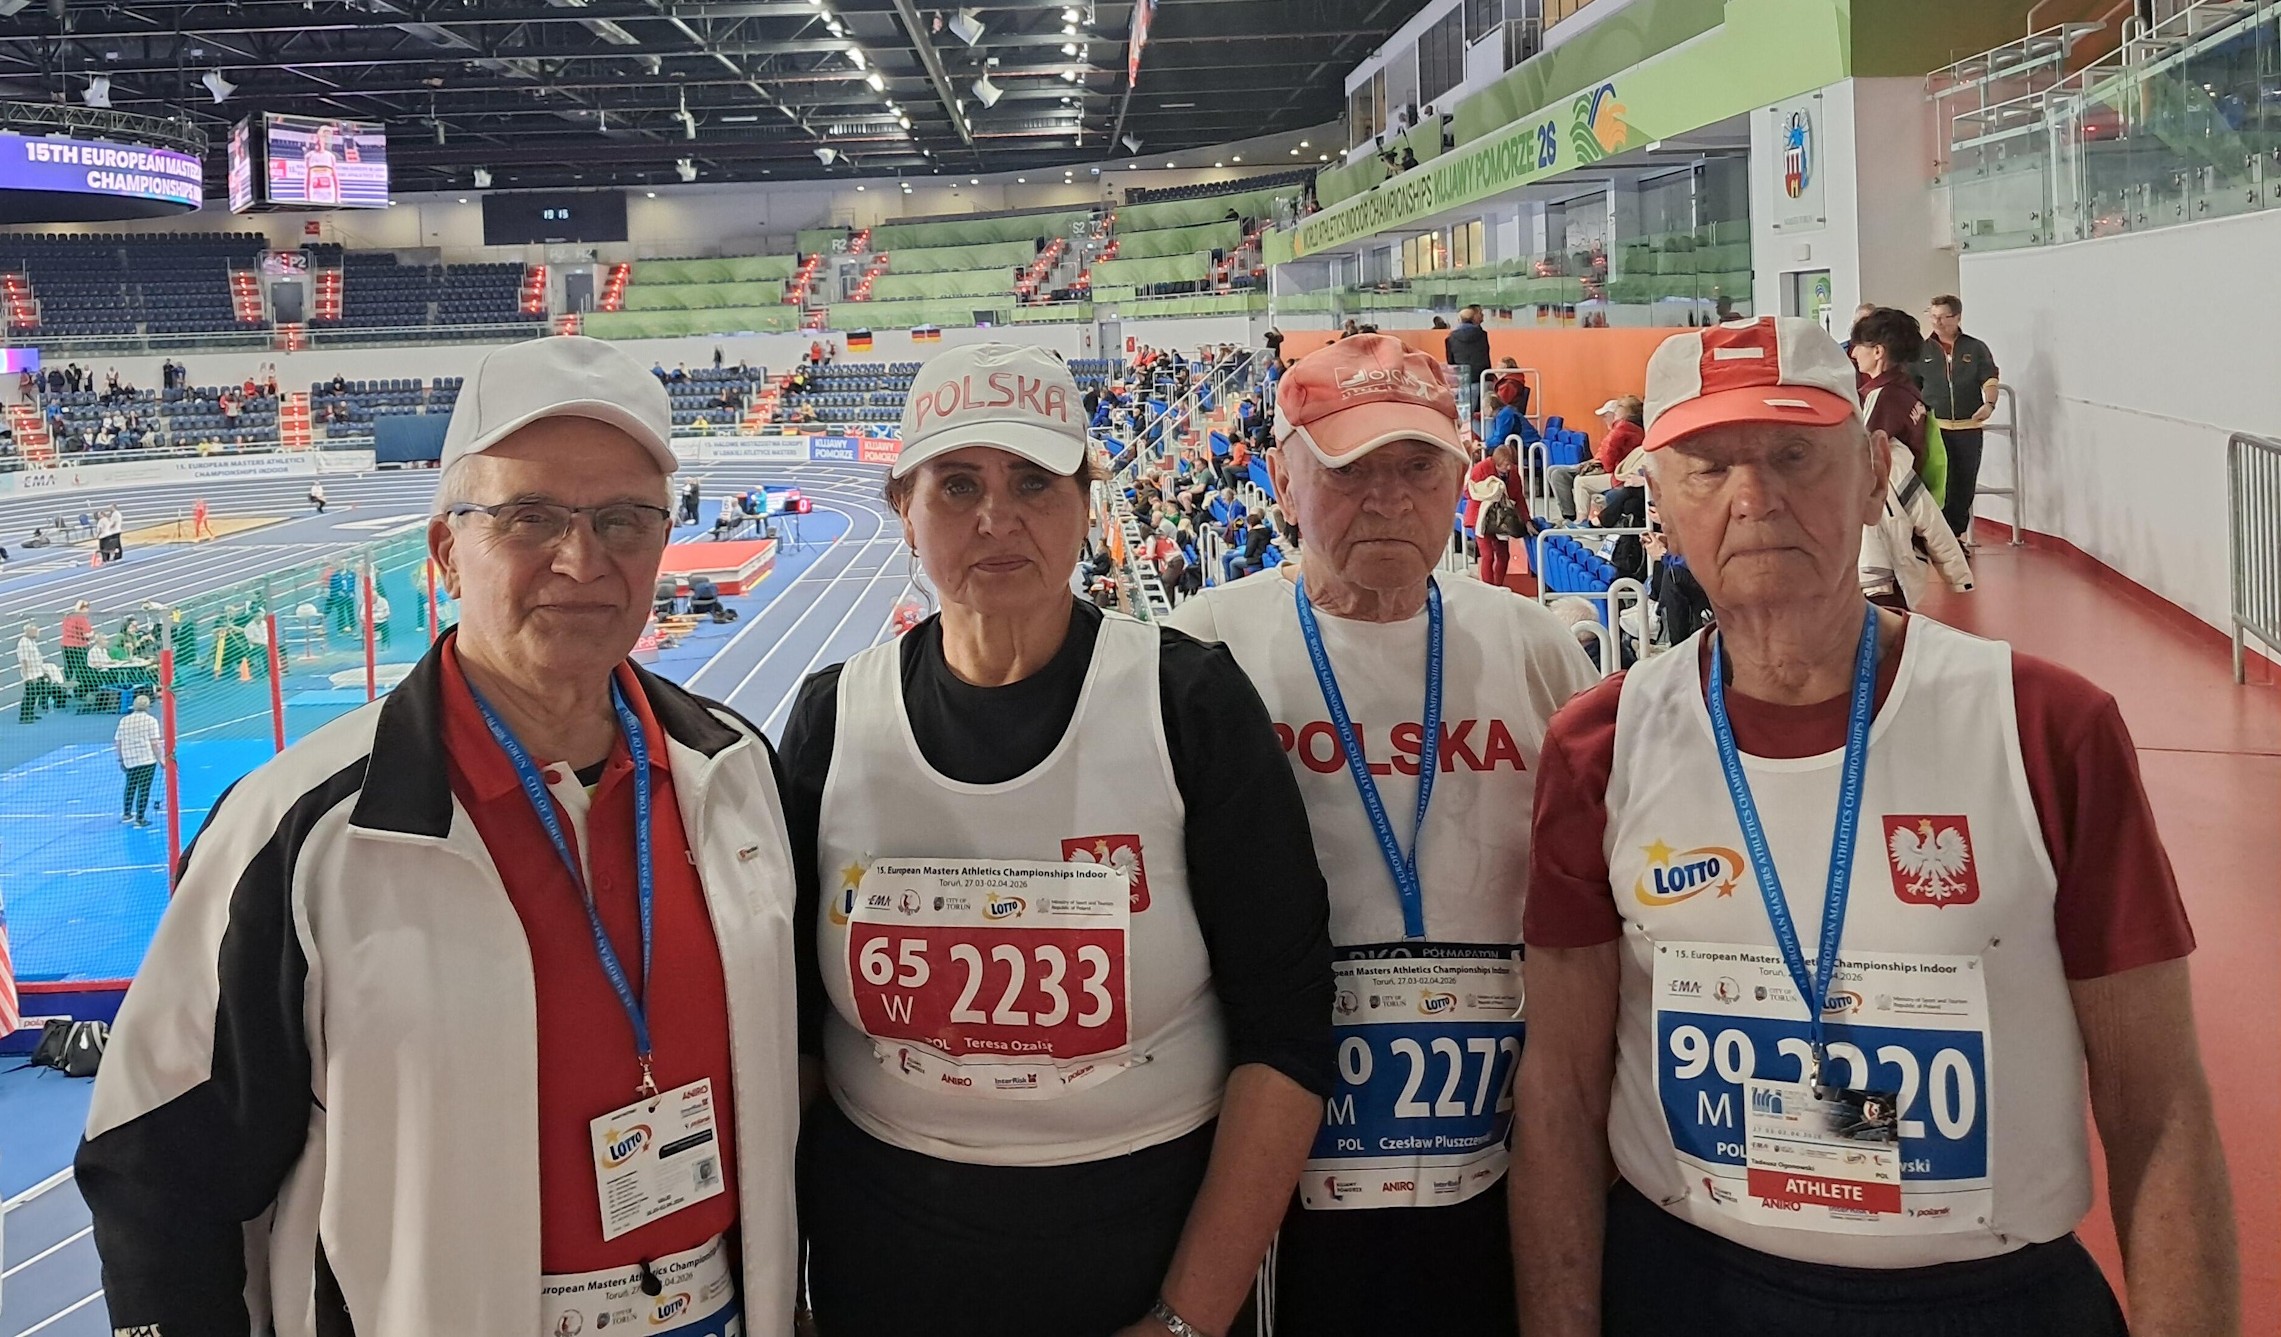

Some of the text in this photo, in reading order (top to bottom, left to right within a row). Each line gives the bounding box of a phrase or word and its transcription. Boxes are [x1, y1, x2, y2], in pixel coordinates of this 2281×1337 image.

[25, 141, 78, 164] 15TH
[81, 147, 165, 173] EUROPEAN
[86, 170, 193, 199] CHAMPIONSHIPS
[1370, 173, 1432, 228] CHAMPIONSHIPS
[1433, 156, 1474, 202] KUJAWY
[1476, 131, 1535, 189] POMORZE
[1537, 119, 1557, 170] 26
[1072, 221, 1085, 234] S2
[832, 239, 847, 250] R2
[290, 255, 306, 268] P2
[915, 372, 1067, 433] POLSKA
[815, 438, 848, 449] KUJAWY
[815, 449, 853, 460] POMORZE
[864, 441, 895, 451] KUJAWY
[188, 461, 230, 470] EUROPEAN
[230, 459, 265, 467] MASTERS
[266, 456, 305, 465] ATHLETICS
[194, 466, 289, 478] CHAMPIONSHIPS INDOOR
[24, 474, 55, 488] EMA
[1432, 622, 1441, 657] INDOOR
[1310, 636, 1326, 671] INDOOR
[1427, 657, 1441, 727] CHAMPIONSHIPS
[1322, 671, 1351, 742] CHAMPIONSHIPS
[1711, 692, 1724, 730] INDOOR
[1272, 718, 1527, 776] POLSKA
[1424, 727, 1436, 778] ATHLETICS
[1349, 741, 1373, 792] ATHLETICS
[1719, 729, 1750, 809] CHAMPIONSHIPS
[526, 775, 541, 800] CITY
[1366, 791, 1388, 835] MASTERS
[1743, 809, 1768, 865] ATHLETICS
[1821, 682, 1869, 983] EUROPEAN MASTERS ATHLETICS CHAMPIONSHIPS INDOOR
[877, 866, 1108, 879] 15. European Masters Athletics Championships Indoor
[1383, 834, 1407, 885] EUROPEAN
[1653, 857, 1720, 894] LOTTO
[1761, 865, 1784, 912] MASTERS
[868, 894, 892, 907] EMA
[991, 901, 1018, 916] LOTTO
[1675, 950, 1689, 959] 15.
[1691, 951, 1737, 962] European
[1740, 953, 1780, 964] Masters
[1777, 915, 1804, 975] EUROPEAN
[596, 935, 625, 994] EUROPEAN
[859, 936, 931, 988] 65
[1356, 967, 1391, 976] Masters
[1393, 965, 1431, 975] Athletics
[1433, 965, 1491, 976] Championships
[1833, 959, 1918, 974] Championships
[1920, 963, 1957, 974] Indoor
[950, 943, 1113, 1028] 2233
[1670, 979, 1701, 994] EMA
[881, 994, 913, 1025] W
[1425, 997, 1450, 1011] LOTTO
[1823, 996, 1853, 1010] LOTTO
[24, 1018, 44, 1027] pola
[964, 1037, 1009, 1050] Teresa
[1670, 1026, 1755, 1084] 90
[1338, 1036, 1373, 1086] 0
[941, 1073, 972, 1088] ANIRO
[1390, 1036, 1521, 1118] 2272
[1327, 1094, 1356, 1126] M
[1698, 1091, 1732, 1129] M
[609, 1131, 642, 1161] LOTTO
[1337, 1136, 1432, 1150] POL Czesław
[1716, 1141, 1747, 1159] POL
[1751, 1158, 1777, 1168] Tadeusz
[1875, 1172, 1889, 1180] POL
[1383, 1181, 1415, 1192] ANIRO
[1785, 1179, 1863, 1201] ATHLETE
[587, 1278, 627, 1291] Masters
[658, 1298, 683, 1319] LOTTO
